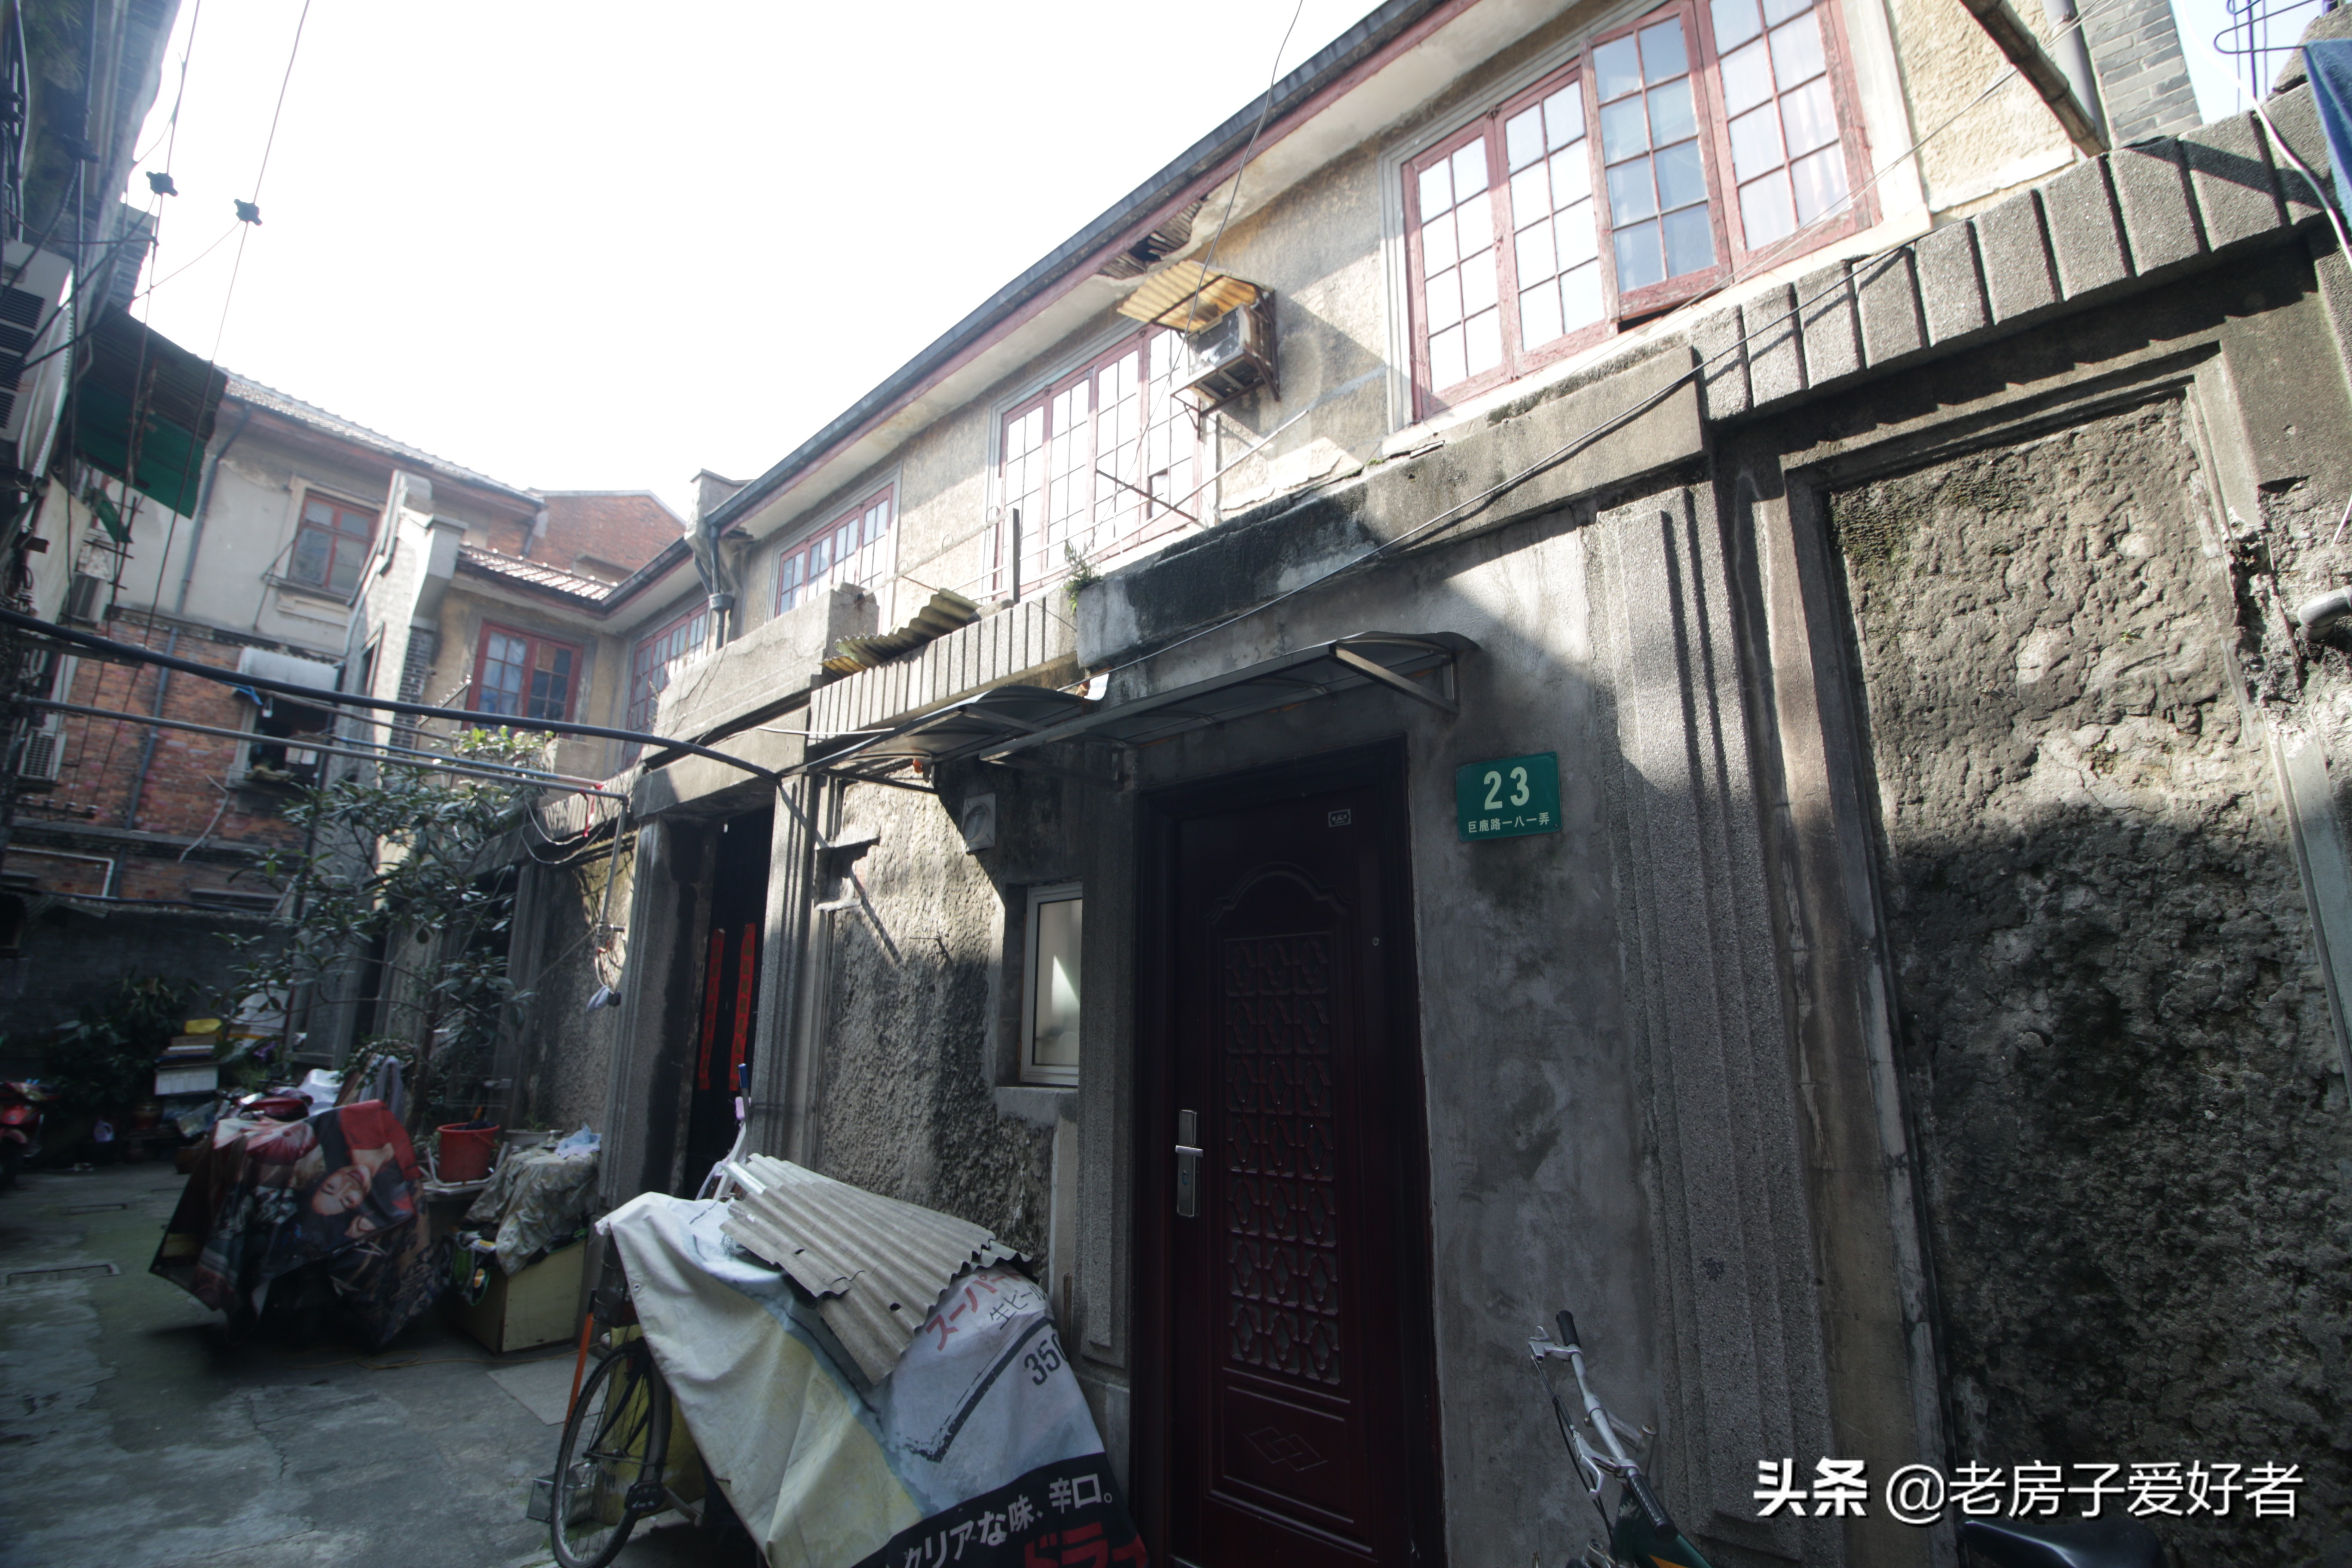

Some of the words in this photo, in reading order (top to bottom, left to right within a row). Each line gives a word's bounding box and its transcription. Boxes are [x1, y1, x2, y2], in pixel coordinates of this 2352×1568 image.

[1484, 767, 1529, 810] 23
[1469, 812, 1550, 833] 巨鹿路一八一弄
[886, 1473, 1113, 1568] クリアな味、辛口。
